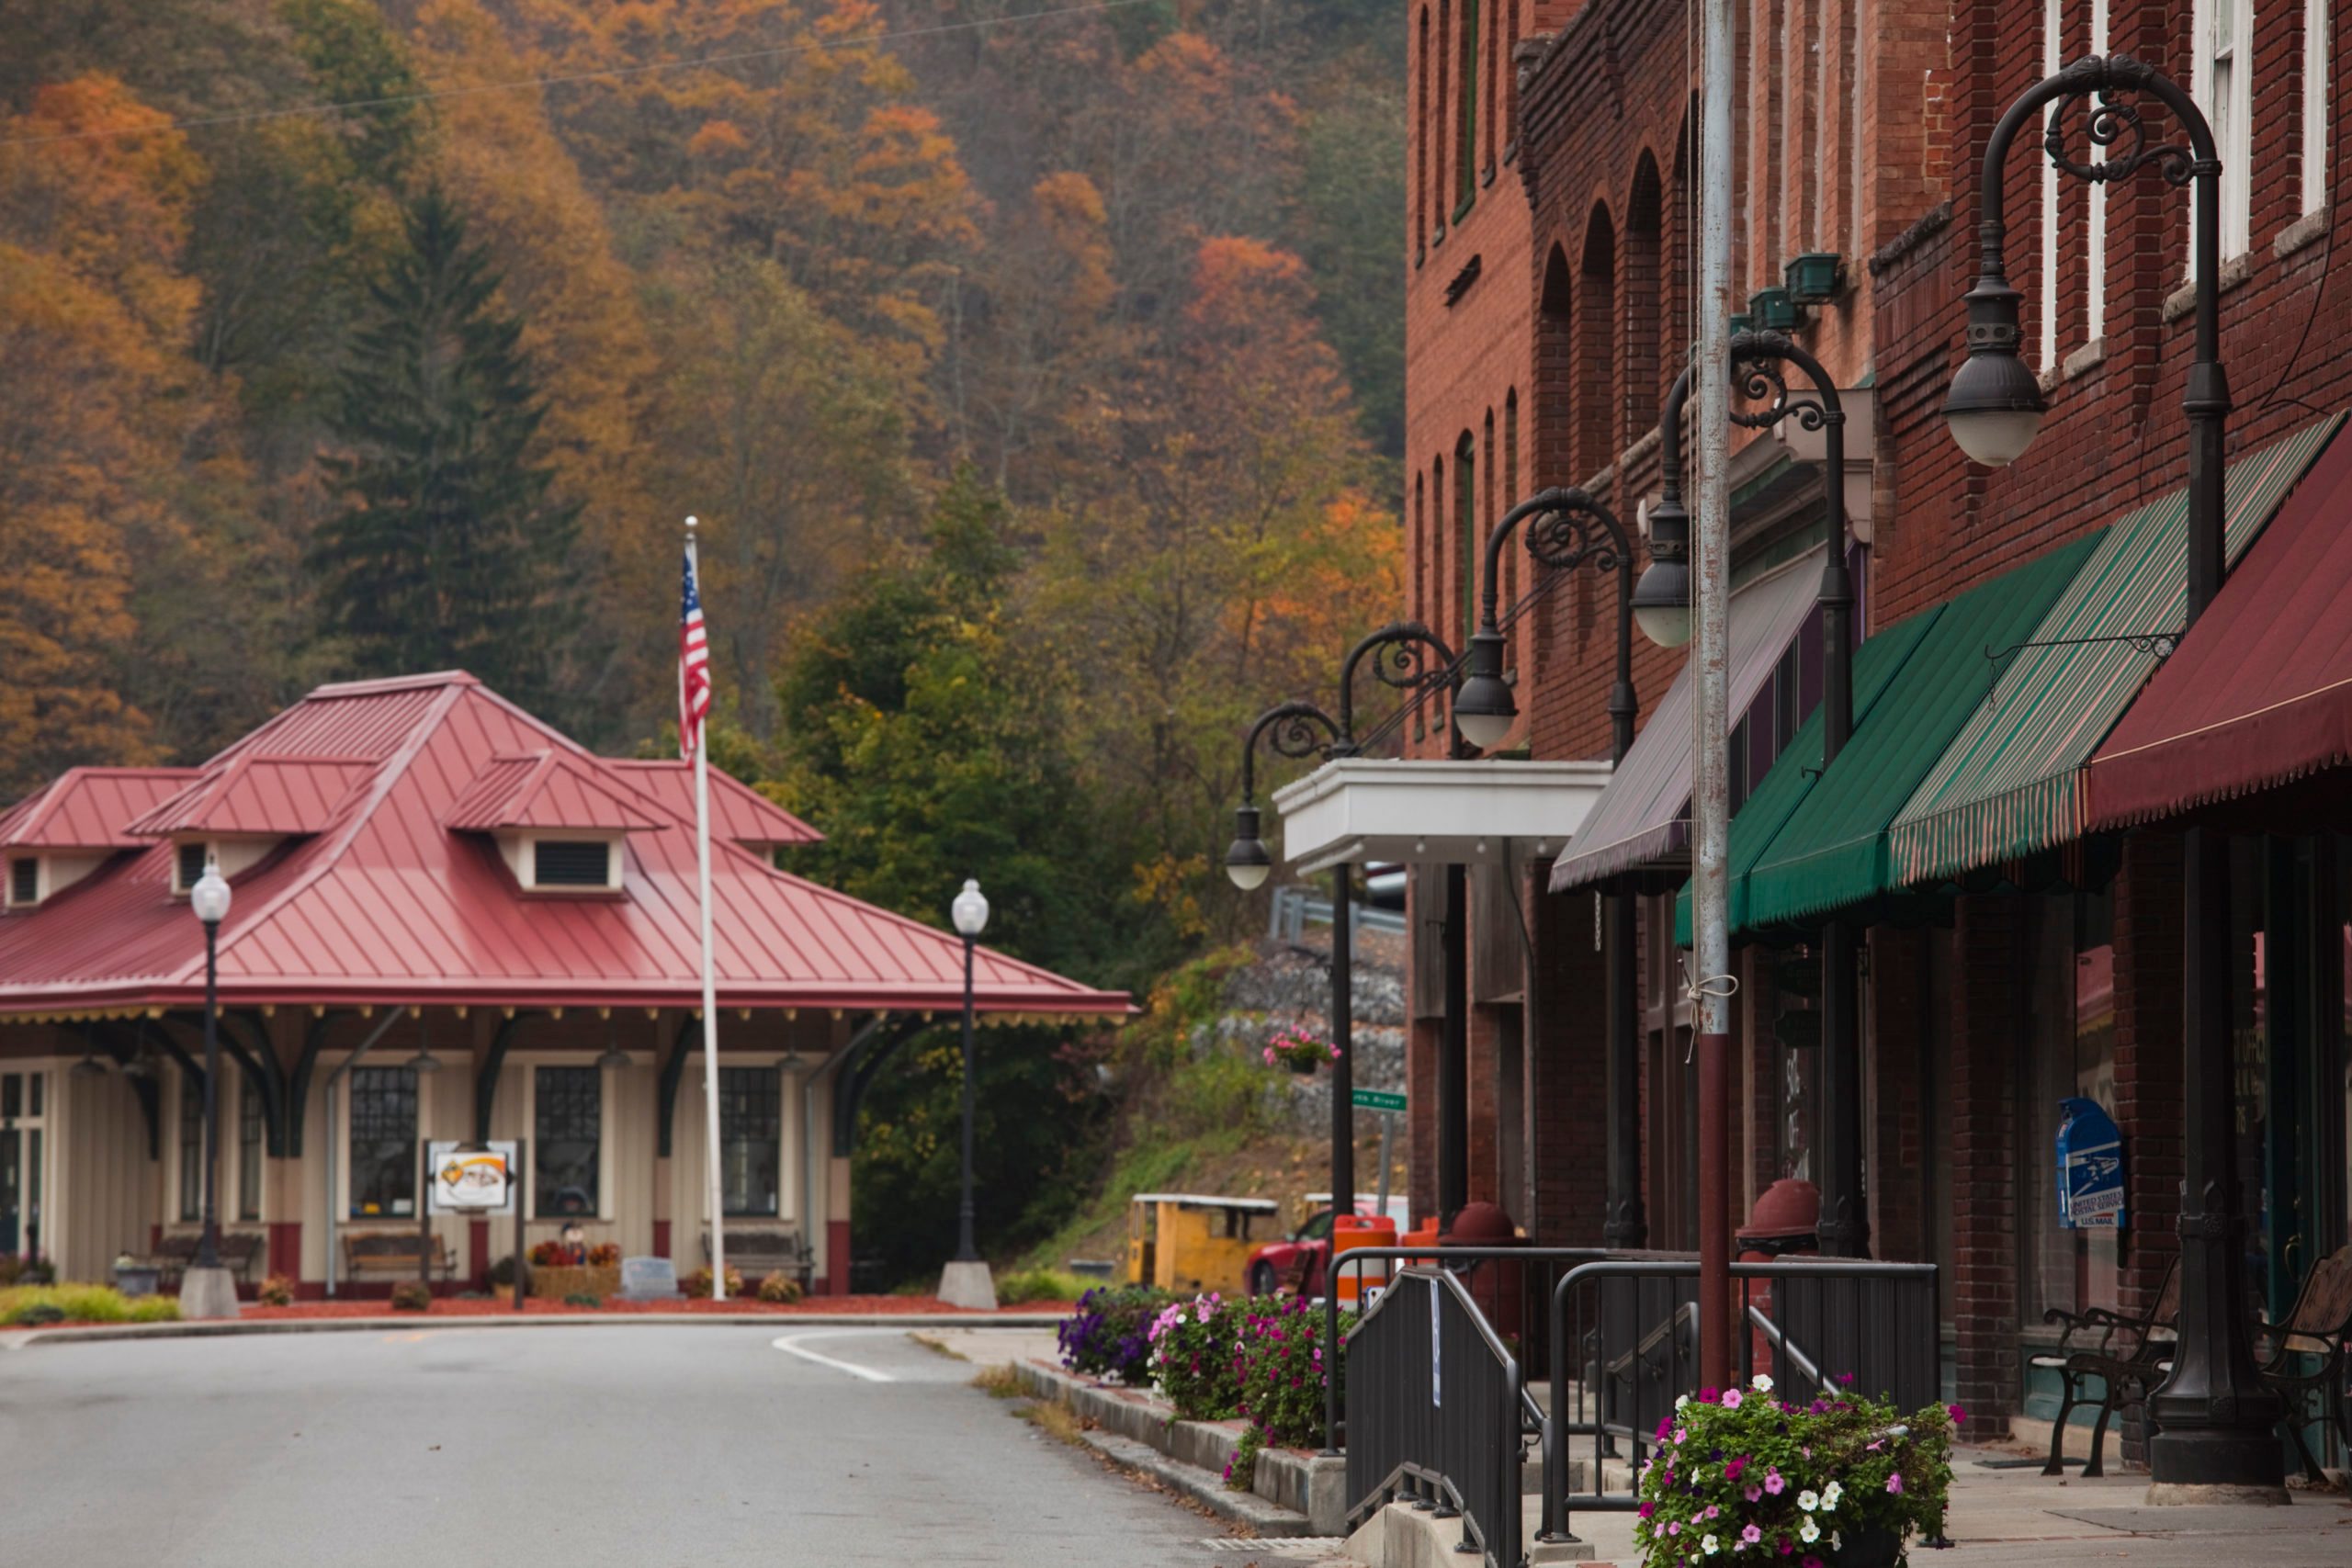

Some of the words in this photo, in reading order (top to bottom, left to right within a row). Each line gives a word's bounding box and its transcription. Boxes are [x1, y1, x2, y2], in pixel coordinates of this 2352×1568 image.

[2071, 1197, 2097, 1209] UNITED
[2098, 1190, 2122, 1203] STATES
[2071, 1206, 2097, 1217] POSTAL
